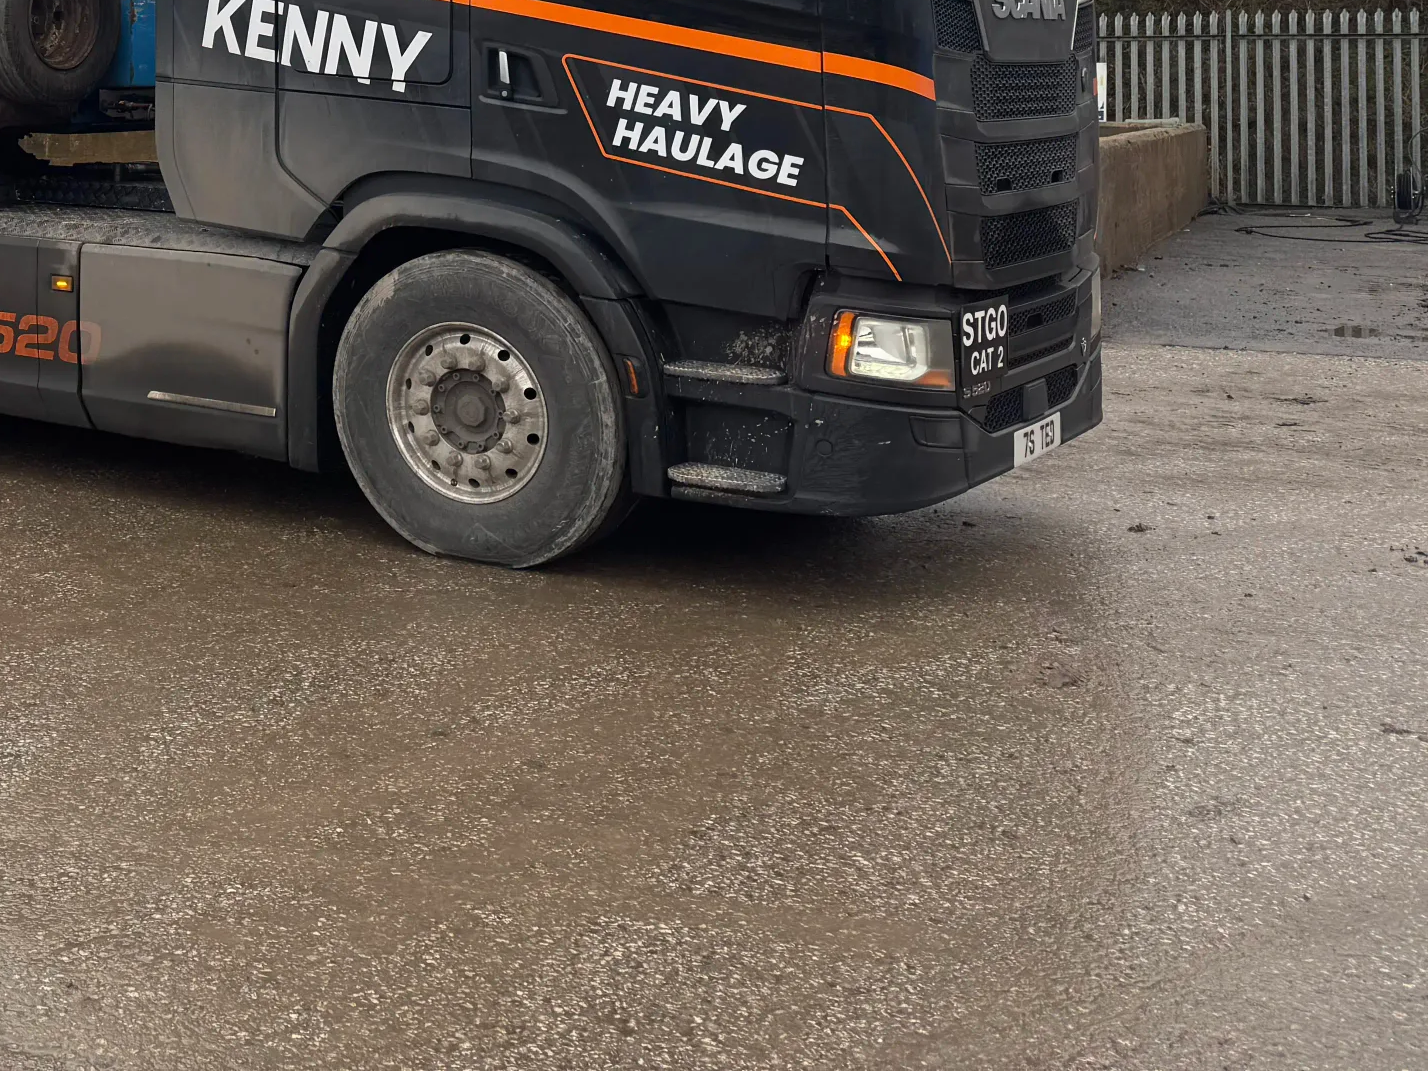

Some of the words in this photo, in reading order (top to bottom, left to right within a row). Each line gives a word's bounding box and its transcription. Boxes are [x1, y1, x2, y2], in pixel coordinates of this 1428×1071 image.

[606, 78, 747, 132] HEAVY
[612, 118, 805, 187] HAULAGE
[962, 304, 1008, 347] STGO
[970, 346, 995, 376] CAT
[997, 345, 1004, 368] 2
[1039, 419, 1055, 450] TED
